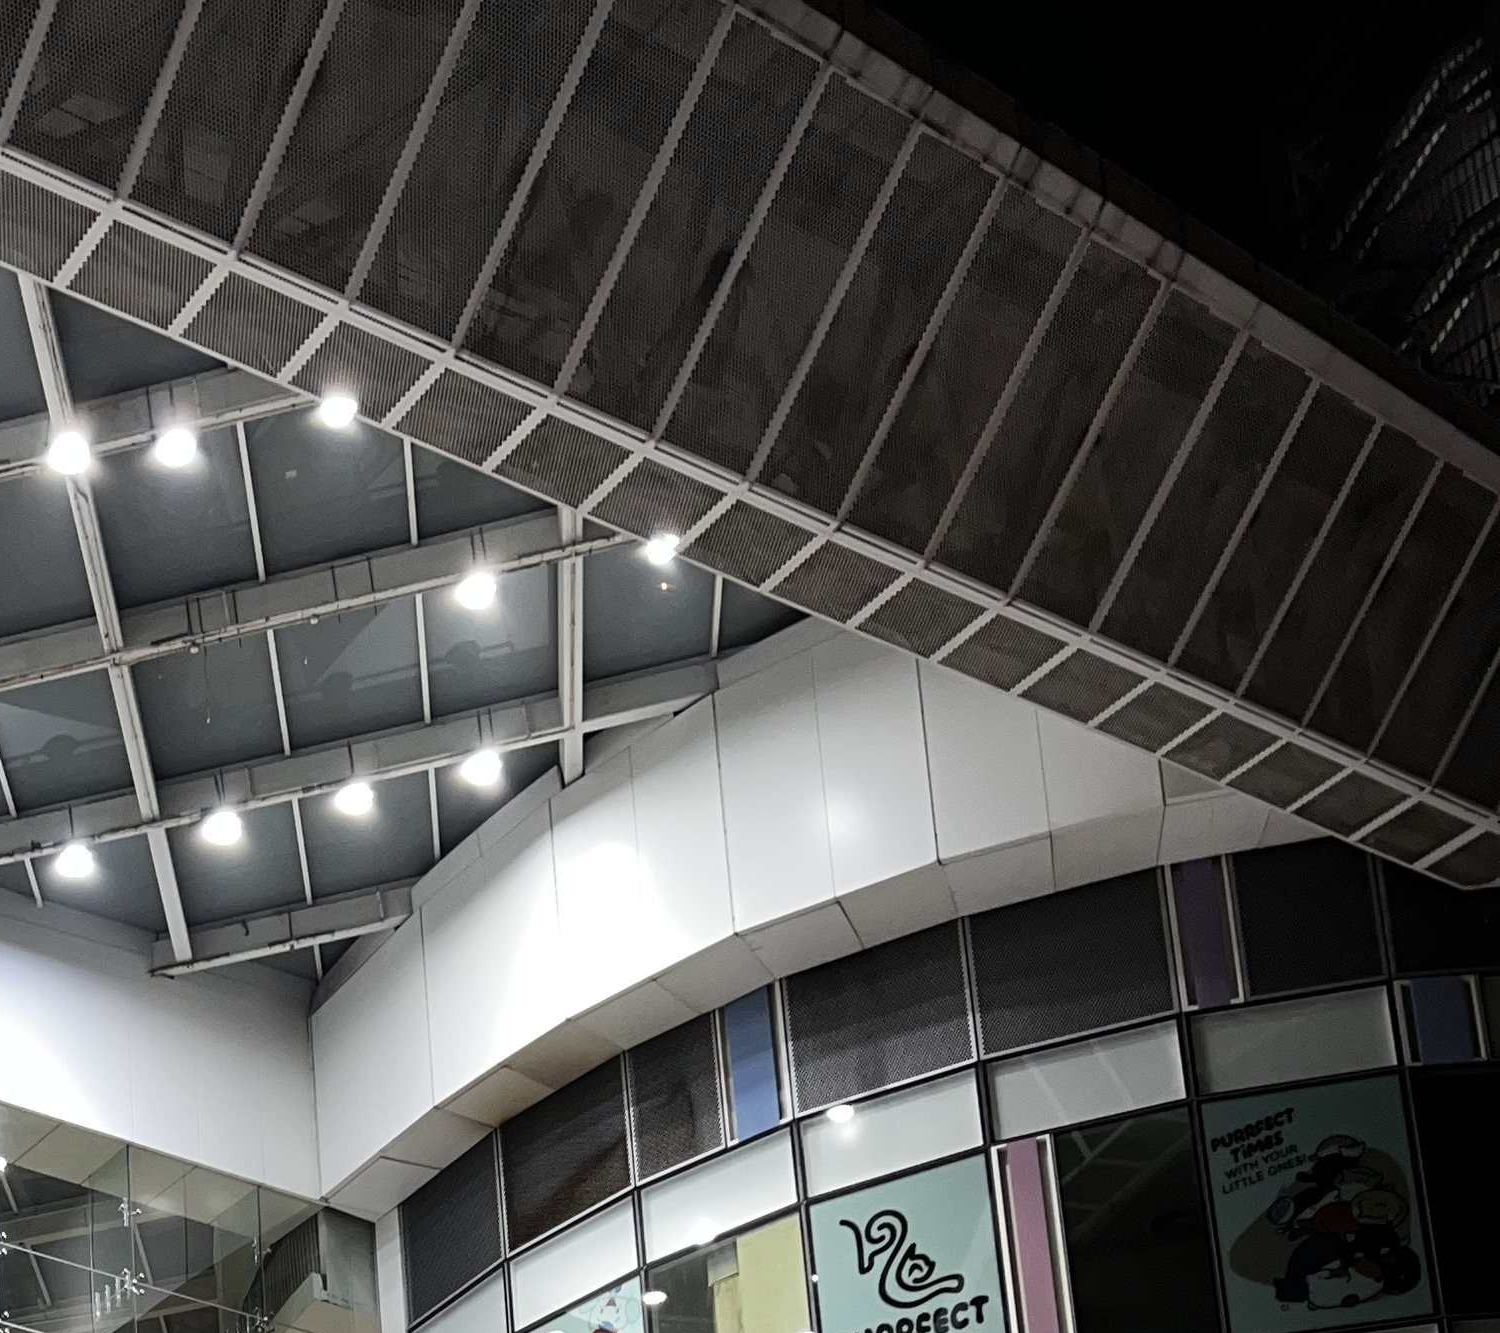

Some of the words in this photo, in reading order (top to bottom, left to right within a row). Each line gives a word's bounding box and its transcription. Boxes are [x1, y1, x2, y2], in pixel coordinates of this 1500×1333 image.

[1210, 1107, 1294, 1152] PURRFECT
[1262, 1144, 1298, 1163] YOUR
[1221, 1171, 1265, 1194] LITTLE
